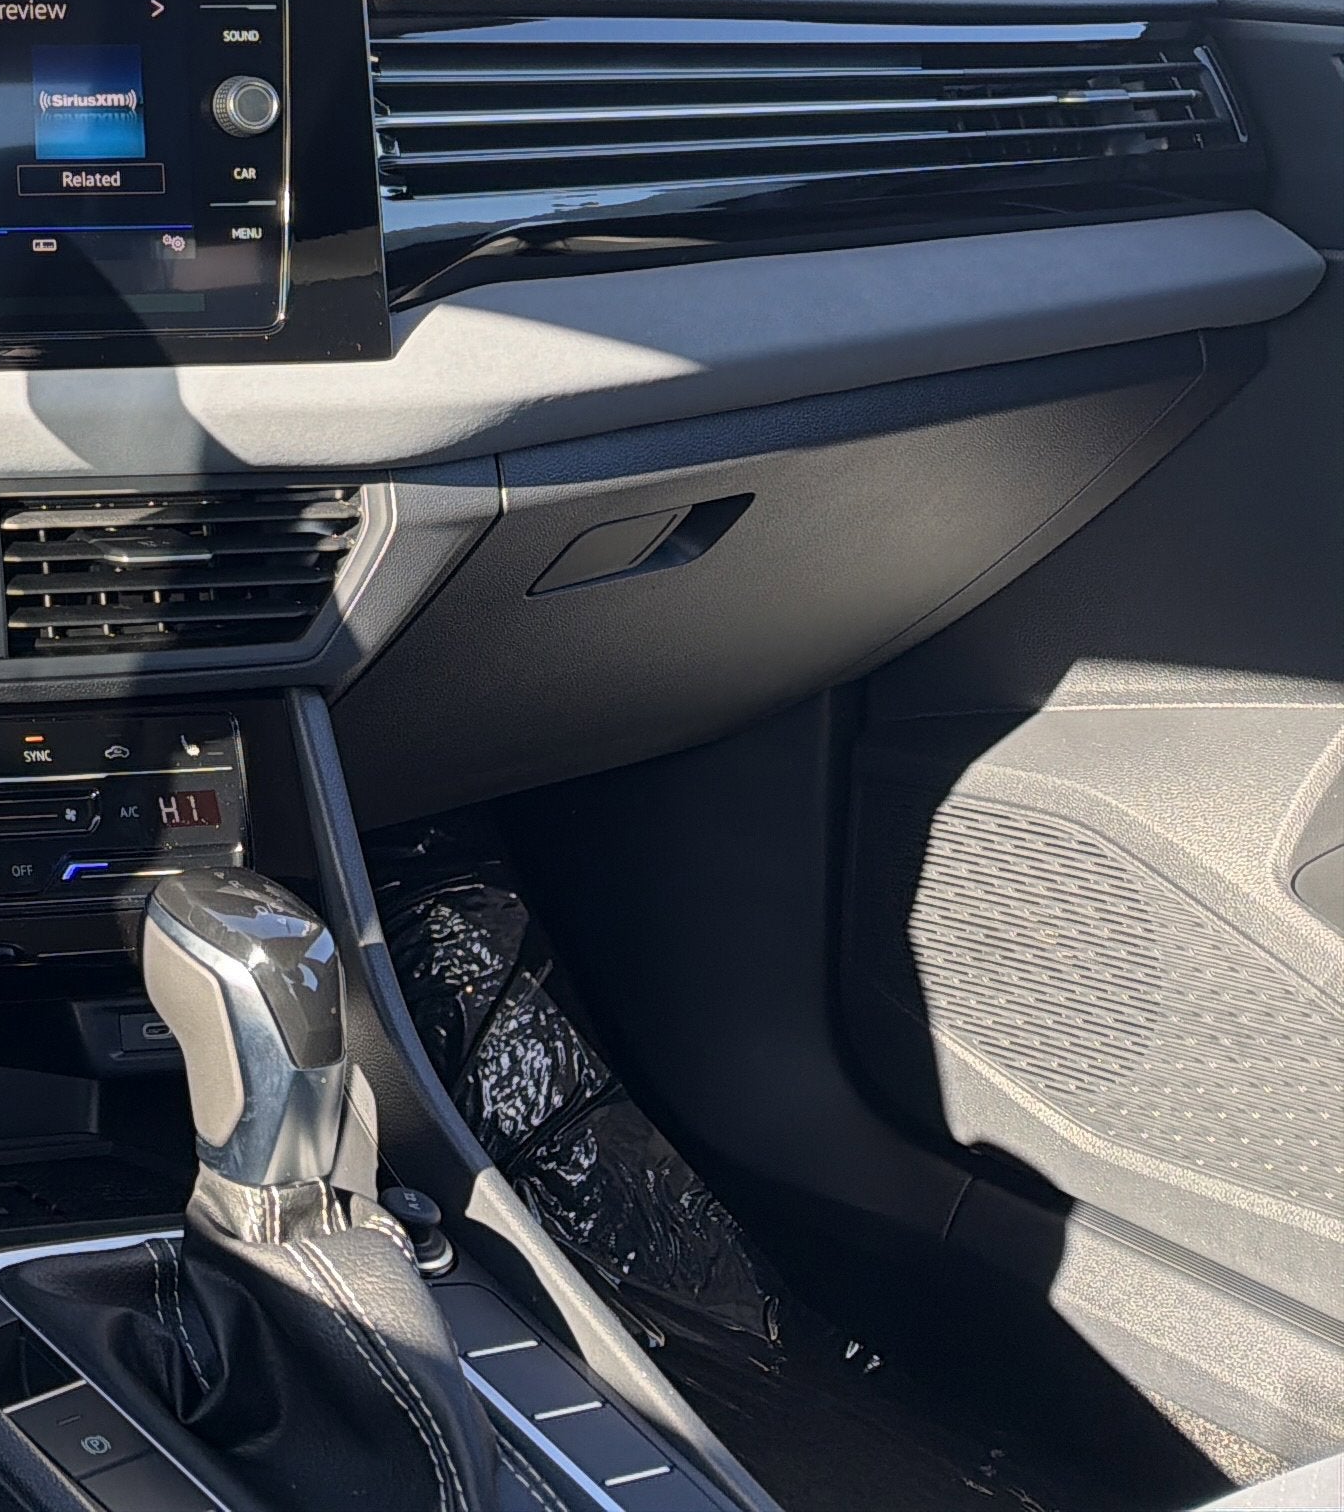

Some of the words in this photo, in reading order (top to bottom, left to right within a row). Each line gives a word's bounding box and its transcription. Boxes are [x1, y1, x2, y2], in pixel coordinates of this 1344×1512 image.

[223, 30, 260, 42] SOUND
[62, 171, 121, 188] Related
[233, 168, 257, 180] CAR
[231, 227, 263, 240] MENU
[23, 749, 53, 763] SYNC
[120, 805, 141, 819] A/C
[11, 863, 34, 878] OFF
